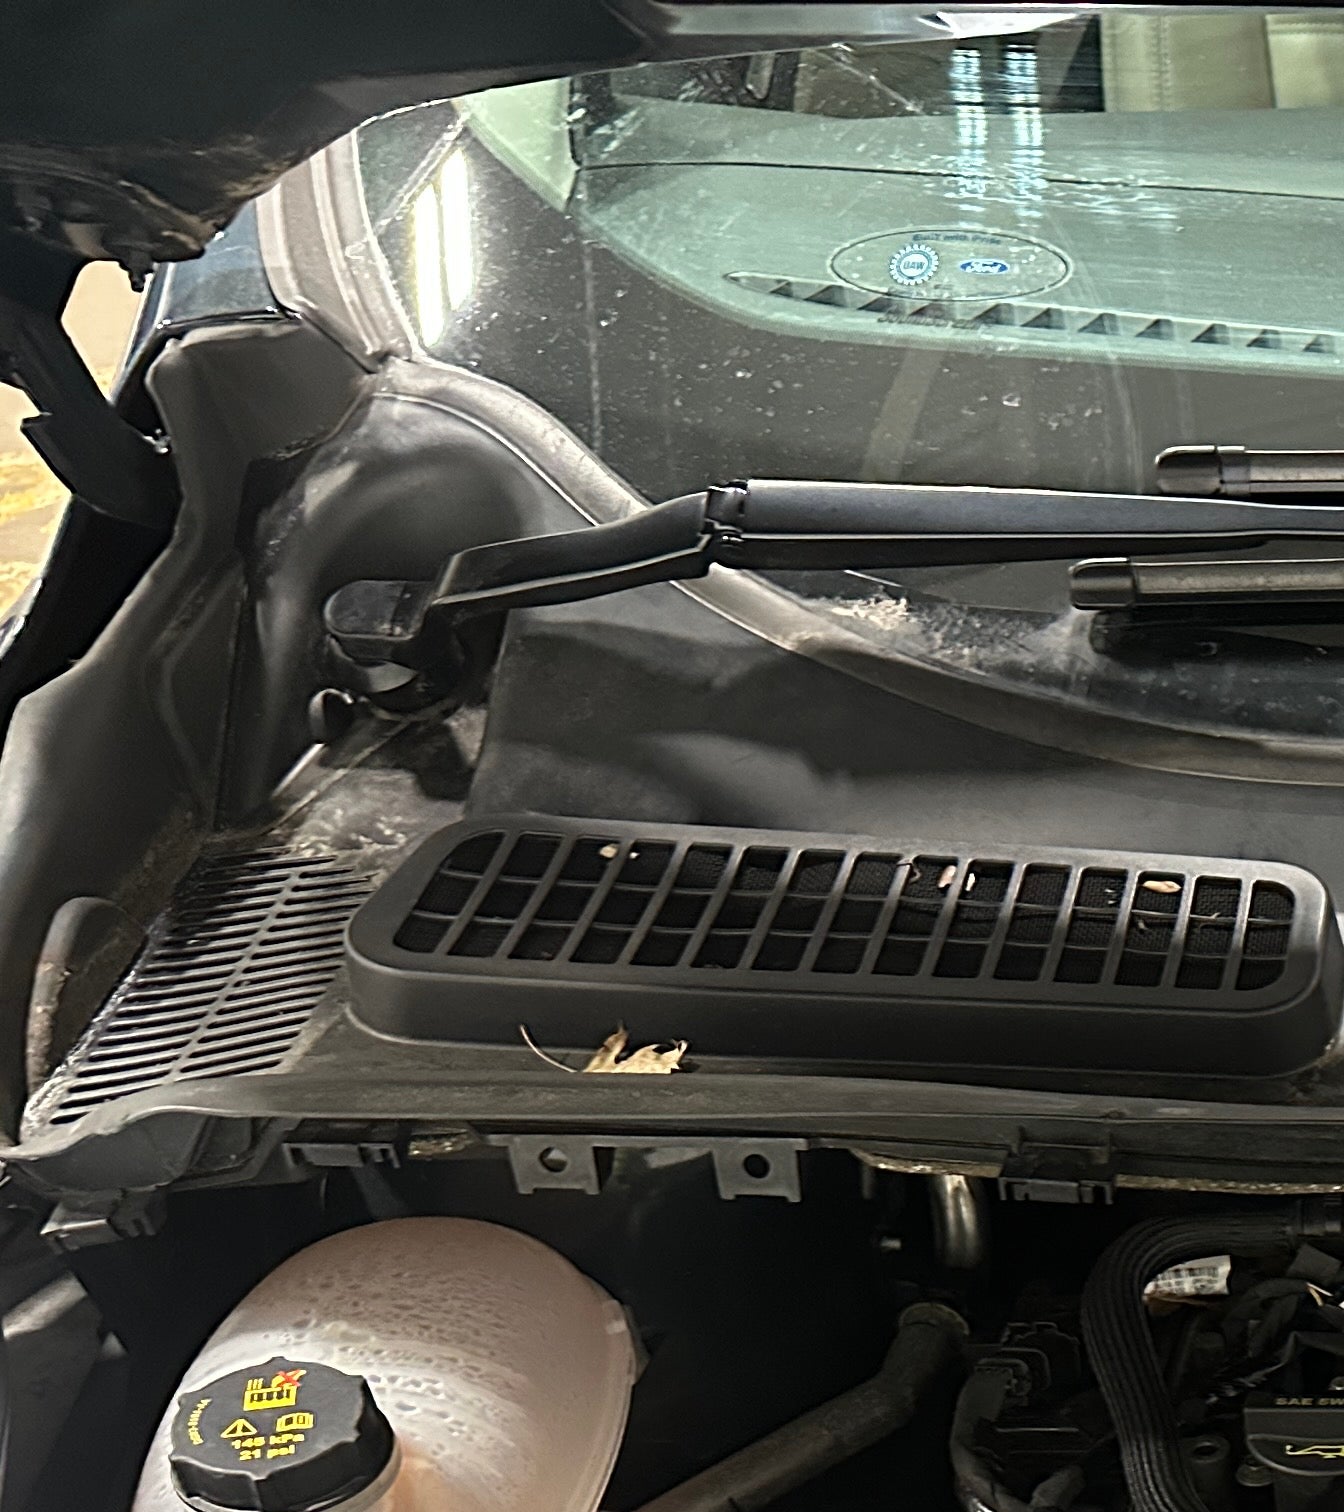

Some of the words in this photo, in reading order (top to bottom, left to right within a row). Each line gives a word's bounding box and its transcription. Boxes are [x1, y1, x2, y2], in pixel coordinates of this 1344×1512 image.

[904, 261, 926, 270] UAW
[963, 260, 1005, 274] Ford
[1275, 1397, 1313, 1406] SAE
[269, 1433, 305, 1446] kPa
[267, 1444, 296, 1459] psi
